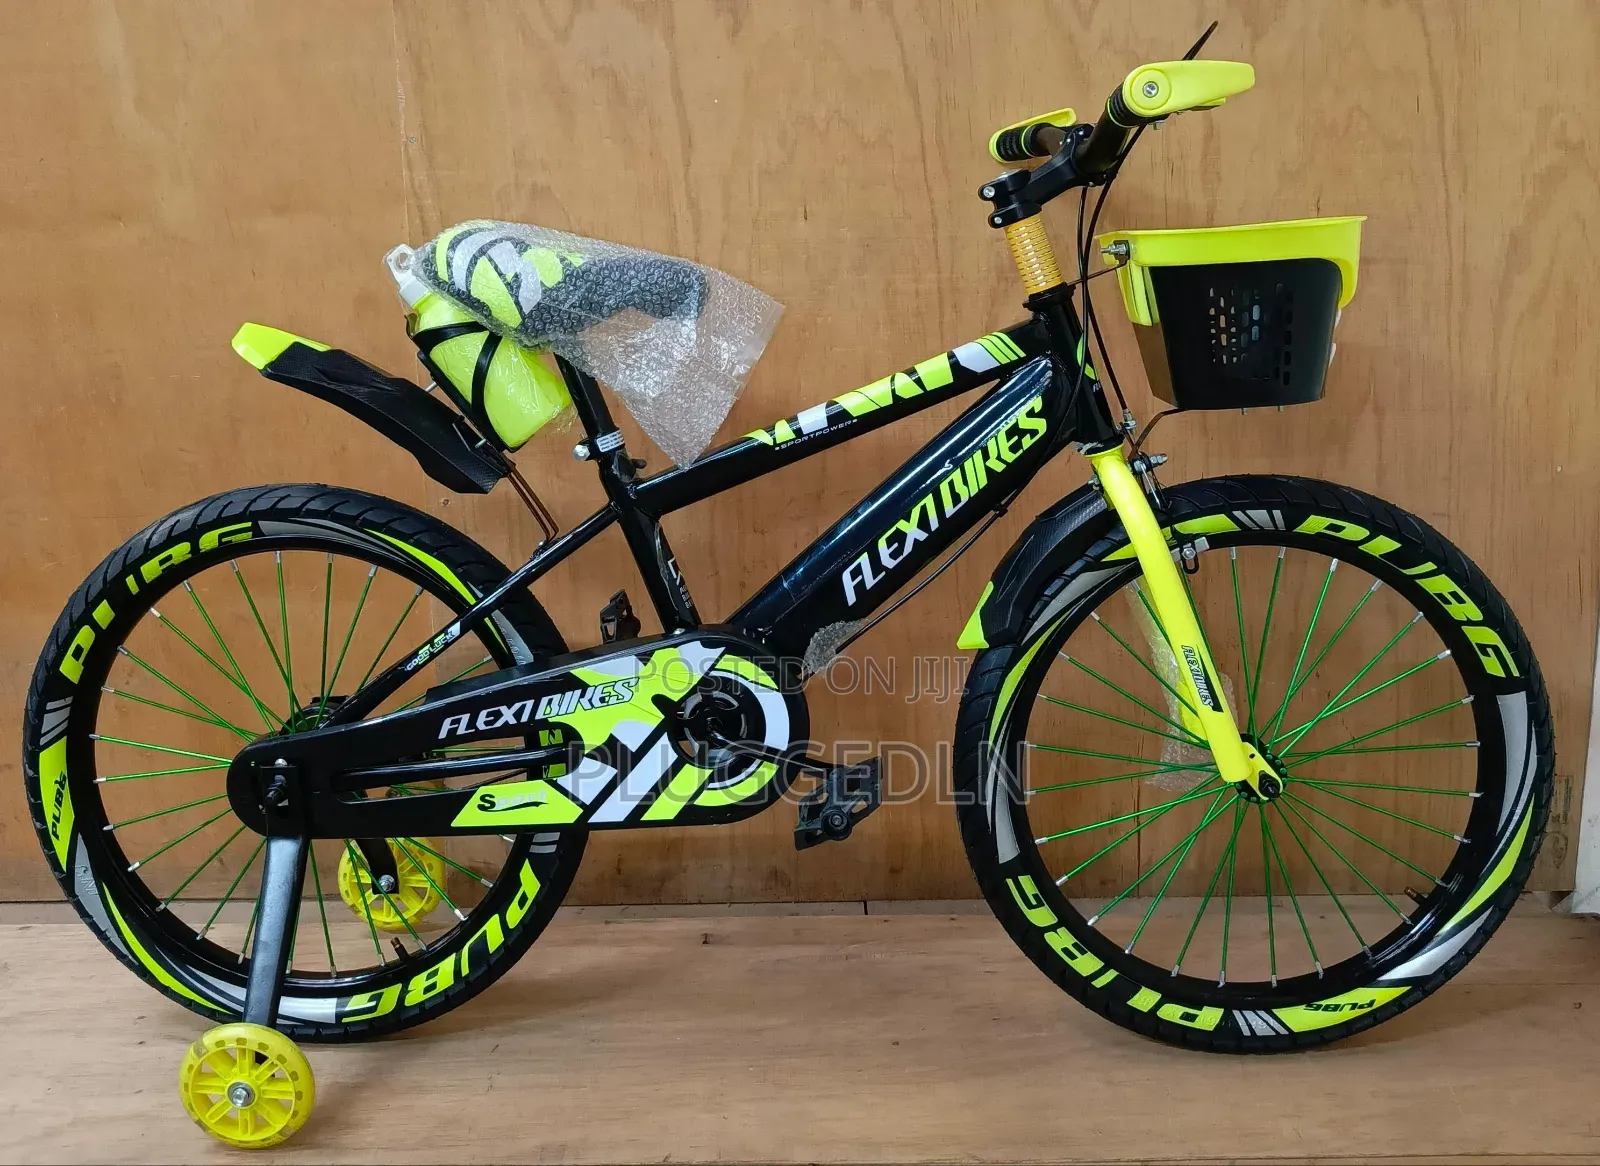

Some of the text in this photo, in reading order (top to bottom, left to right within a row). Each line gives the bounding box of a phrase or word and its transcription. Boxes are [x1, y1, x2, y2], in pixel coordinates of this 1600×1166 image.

[1293, 515, 1520, 678] PUBG
[405, 630, 455, 671] GOOD LUCK
[341, 857, 541, 1024] PUBG
[1303, 998, 1377, 1013] PUBG
